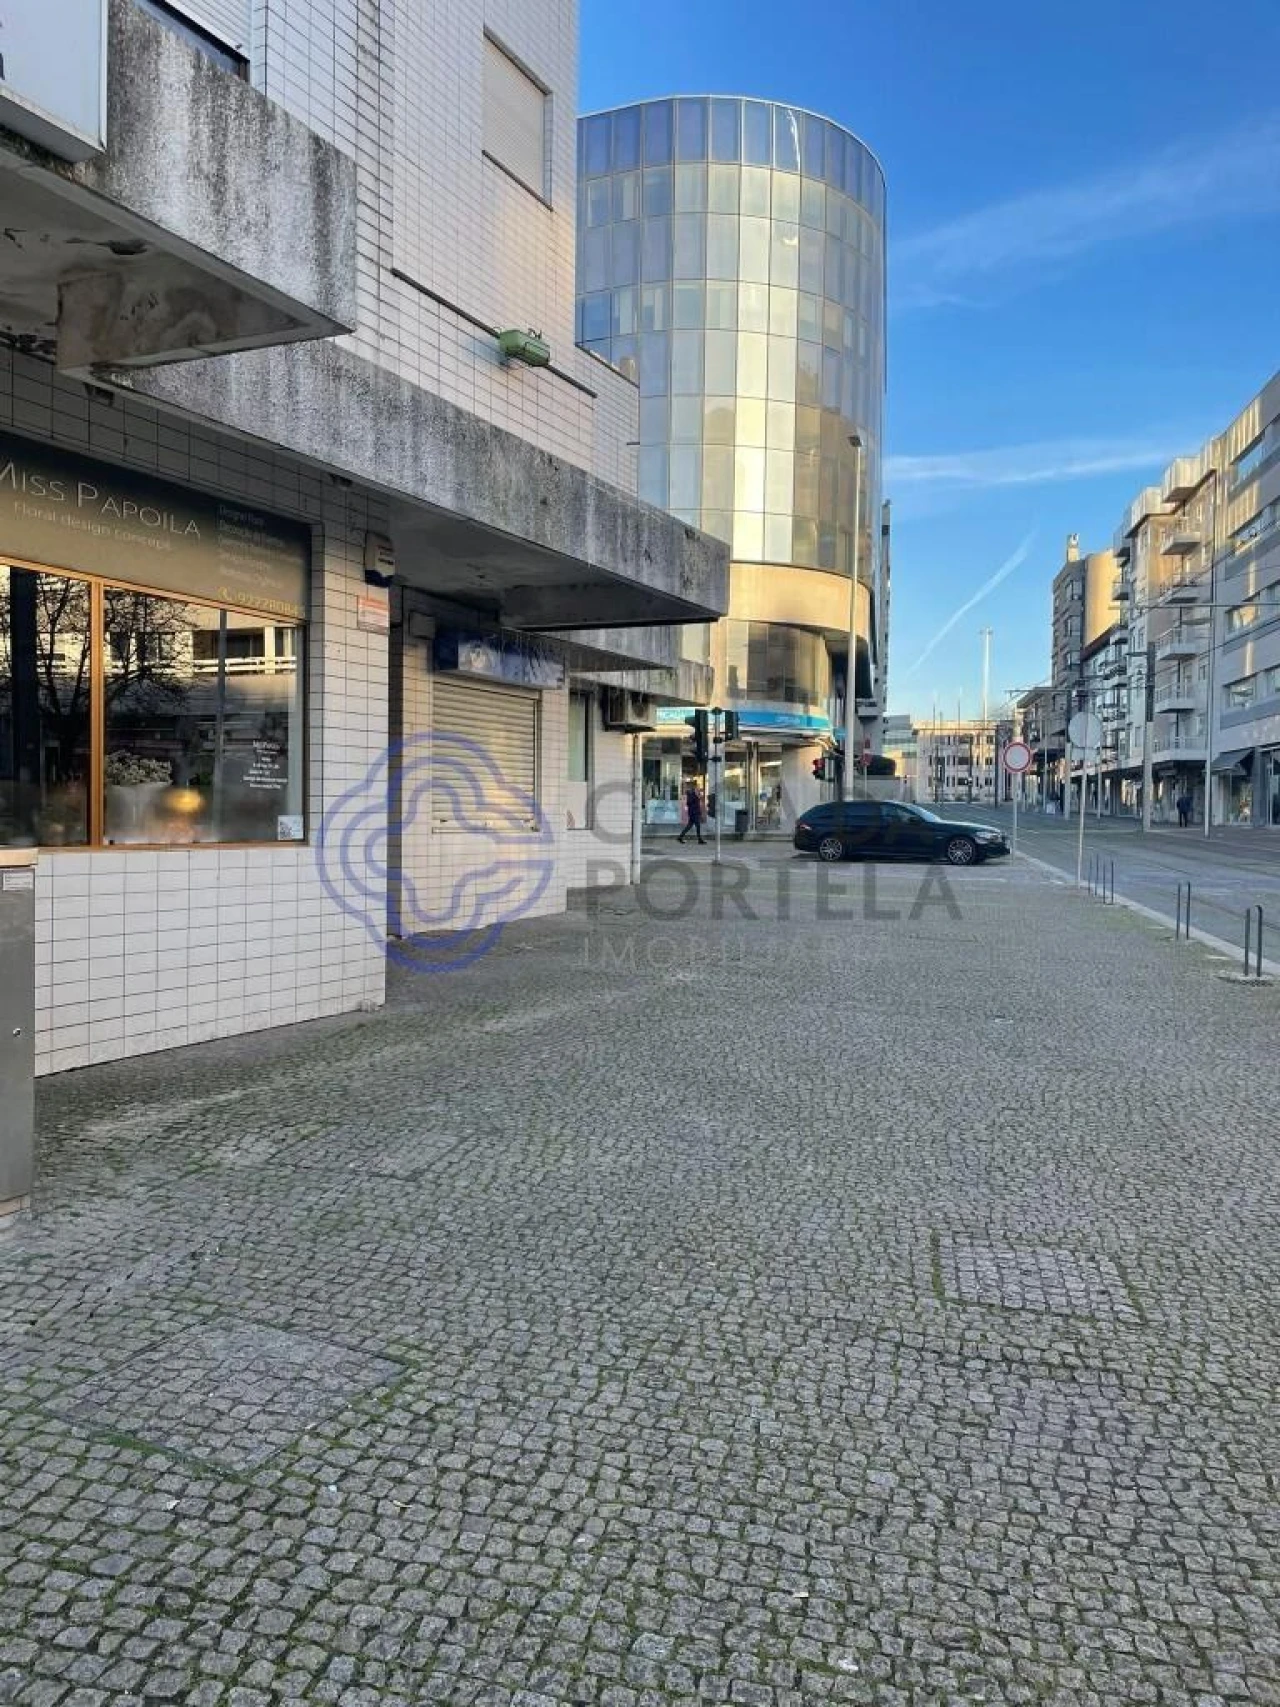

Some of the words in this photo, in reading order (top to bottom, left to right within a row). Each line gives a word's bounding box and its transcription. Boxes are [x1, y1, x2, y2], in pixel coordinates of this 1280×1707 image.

[14, 501, 56, 523] Floral
[61, 513, 110, 536] design
[77, 481, 201, 540] PAPOILA
